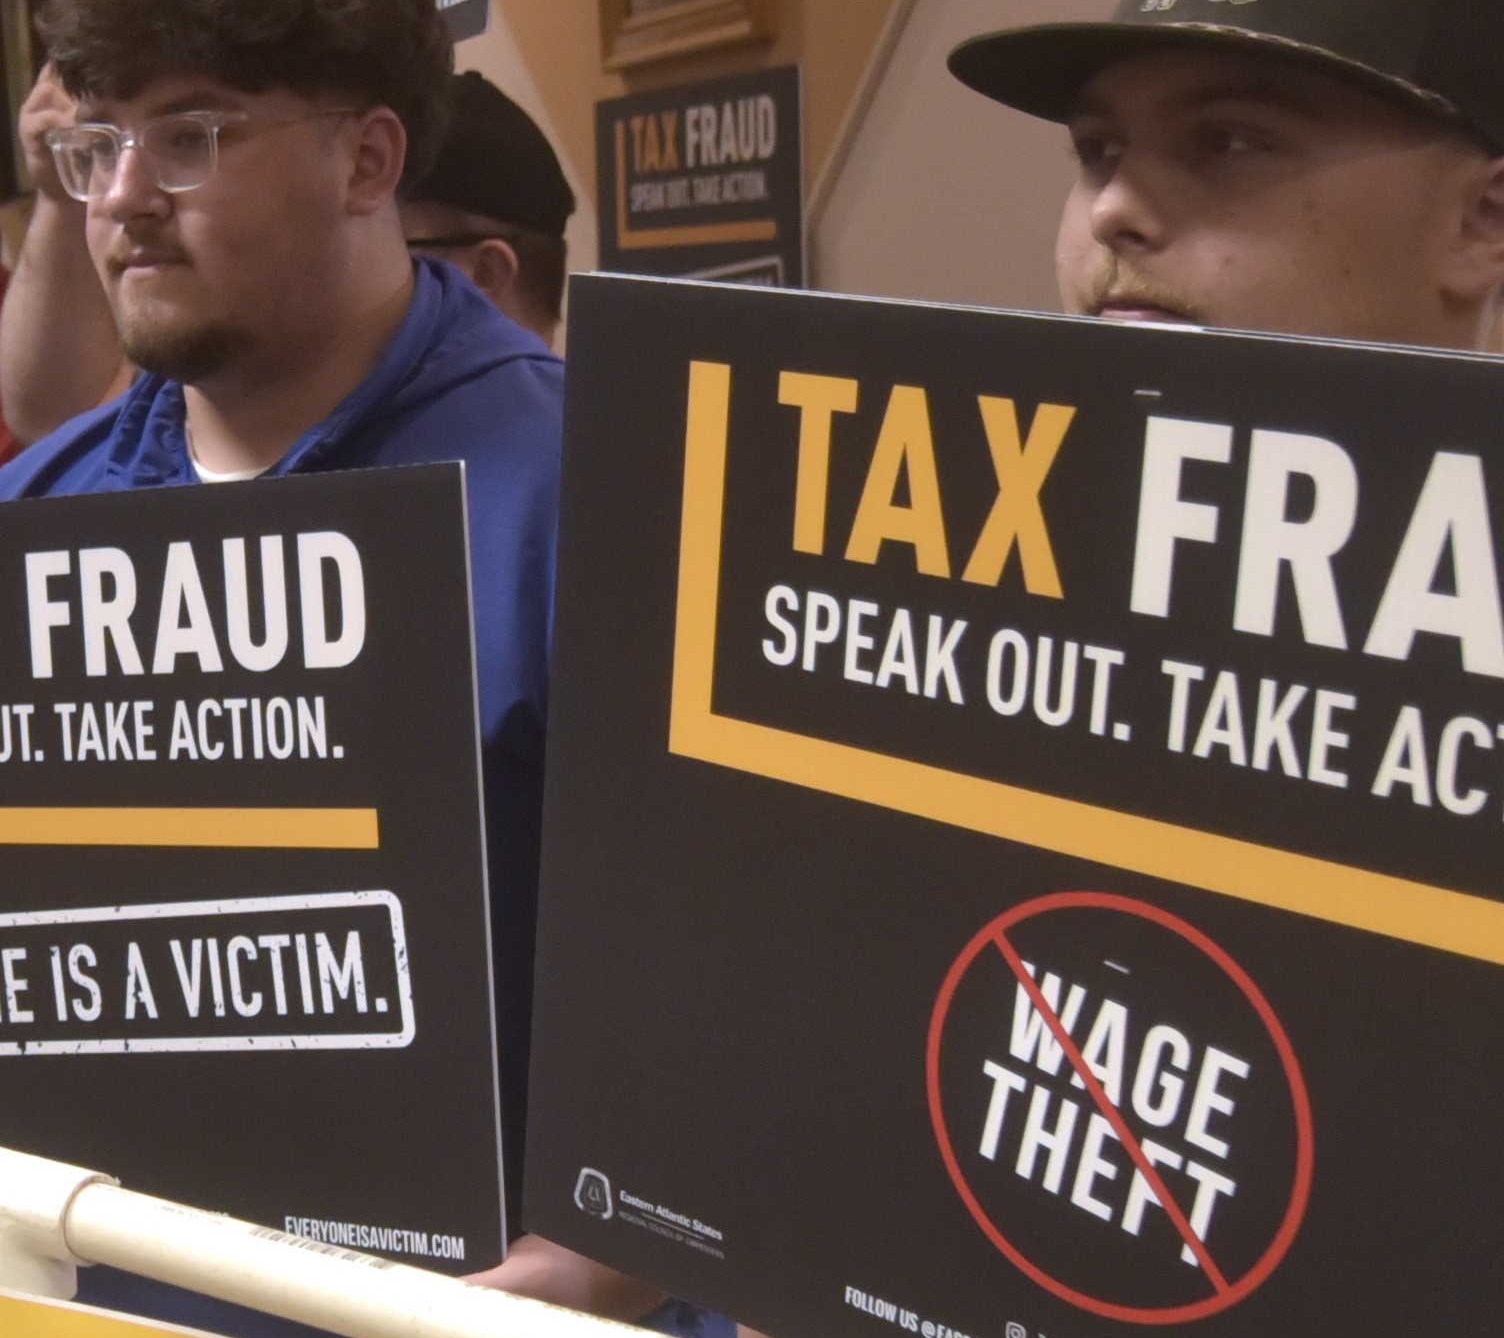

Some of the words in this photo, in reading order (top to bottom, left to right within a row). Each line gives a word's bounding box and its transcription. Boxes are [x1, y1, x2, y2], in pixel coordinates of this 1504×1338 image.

[630, 111, 680, 175] TAX
[686, 94, 778, 168] FRAUD
[776, 371, 1077, 601] TAX
[24, 530, 368, 681] FRAUD
[54, 698, 157, 762] TAKE
[169, 694, 345, 762] ACTION.
[761, 584, 969, 705] SPEAK
[985, 627, 1132, 742] OUT.
[1160, 659, 1358, 789] TAKE
[50, 942, 103, 1023] IS
[125, 941, 159, 1021] A
[170, 929, 390, 1019] VICTIM.
[1008, 961, 1250, 1159] WAGE
[977, 1058, 1237, 1268] THEFT
[285, 1215, 466, 1261] EVERYONEISAVICTIM.COM
[619, 1190, 654, 1213] Eastern
[656, 1205, 691, 1228] Atlantic
[692, 1218, 724, 1242] States
[845, 1285, 897, 1323] FOLLOW
[899, 1309, 919, 1334] US
